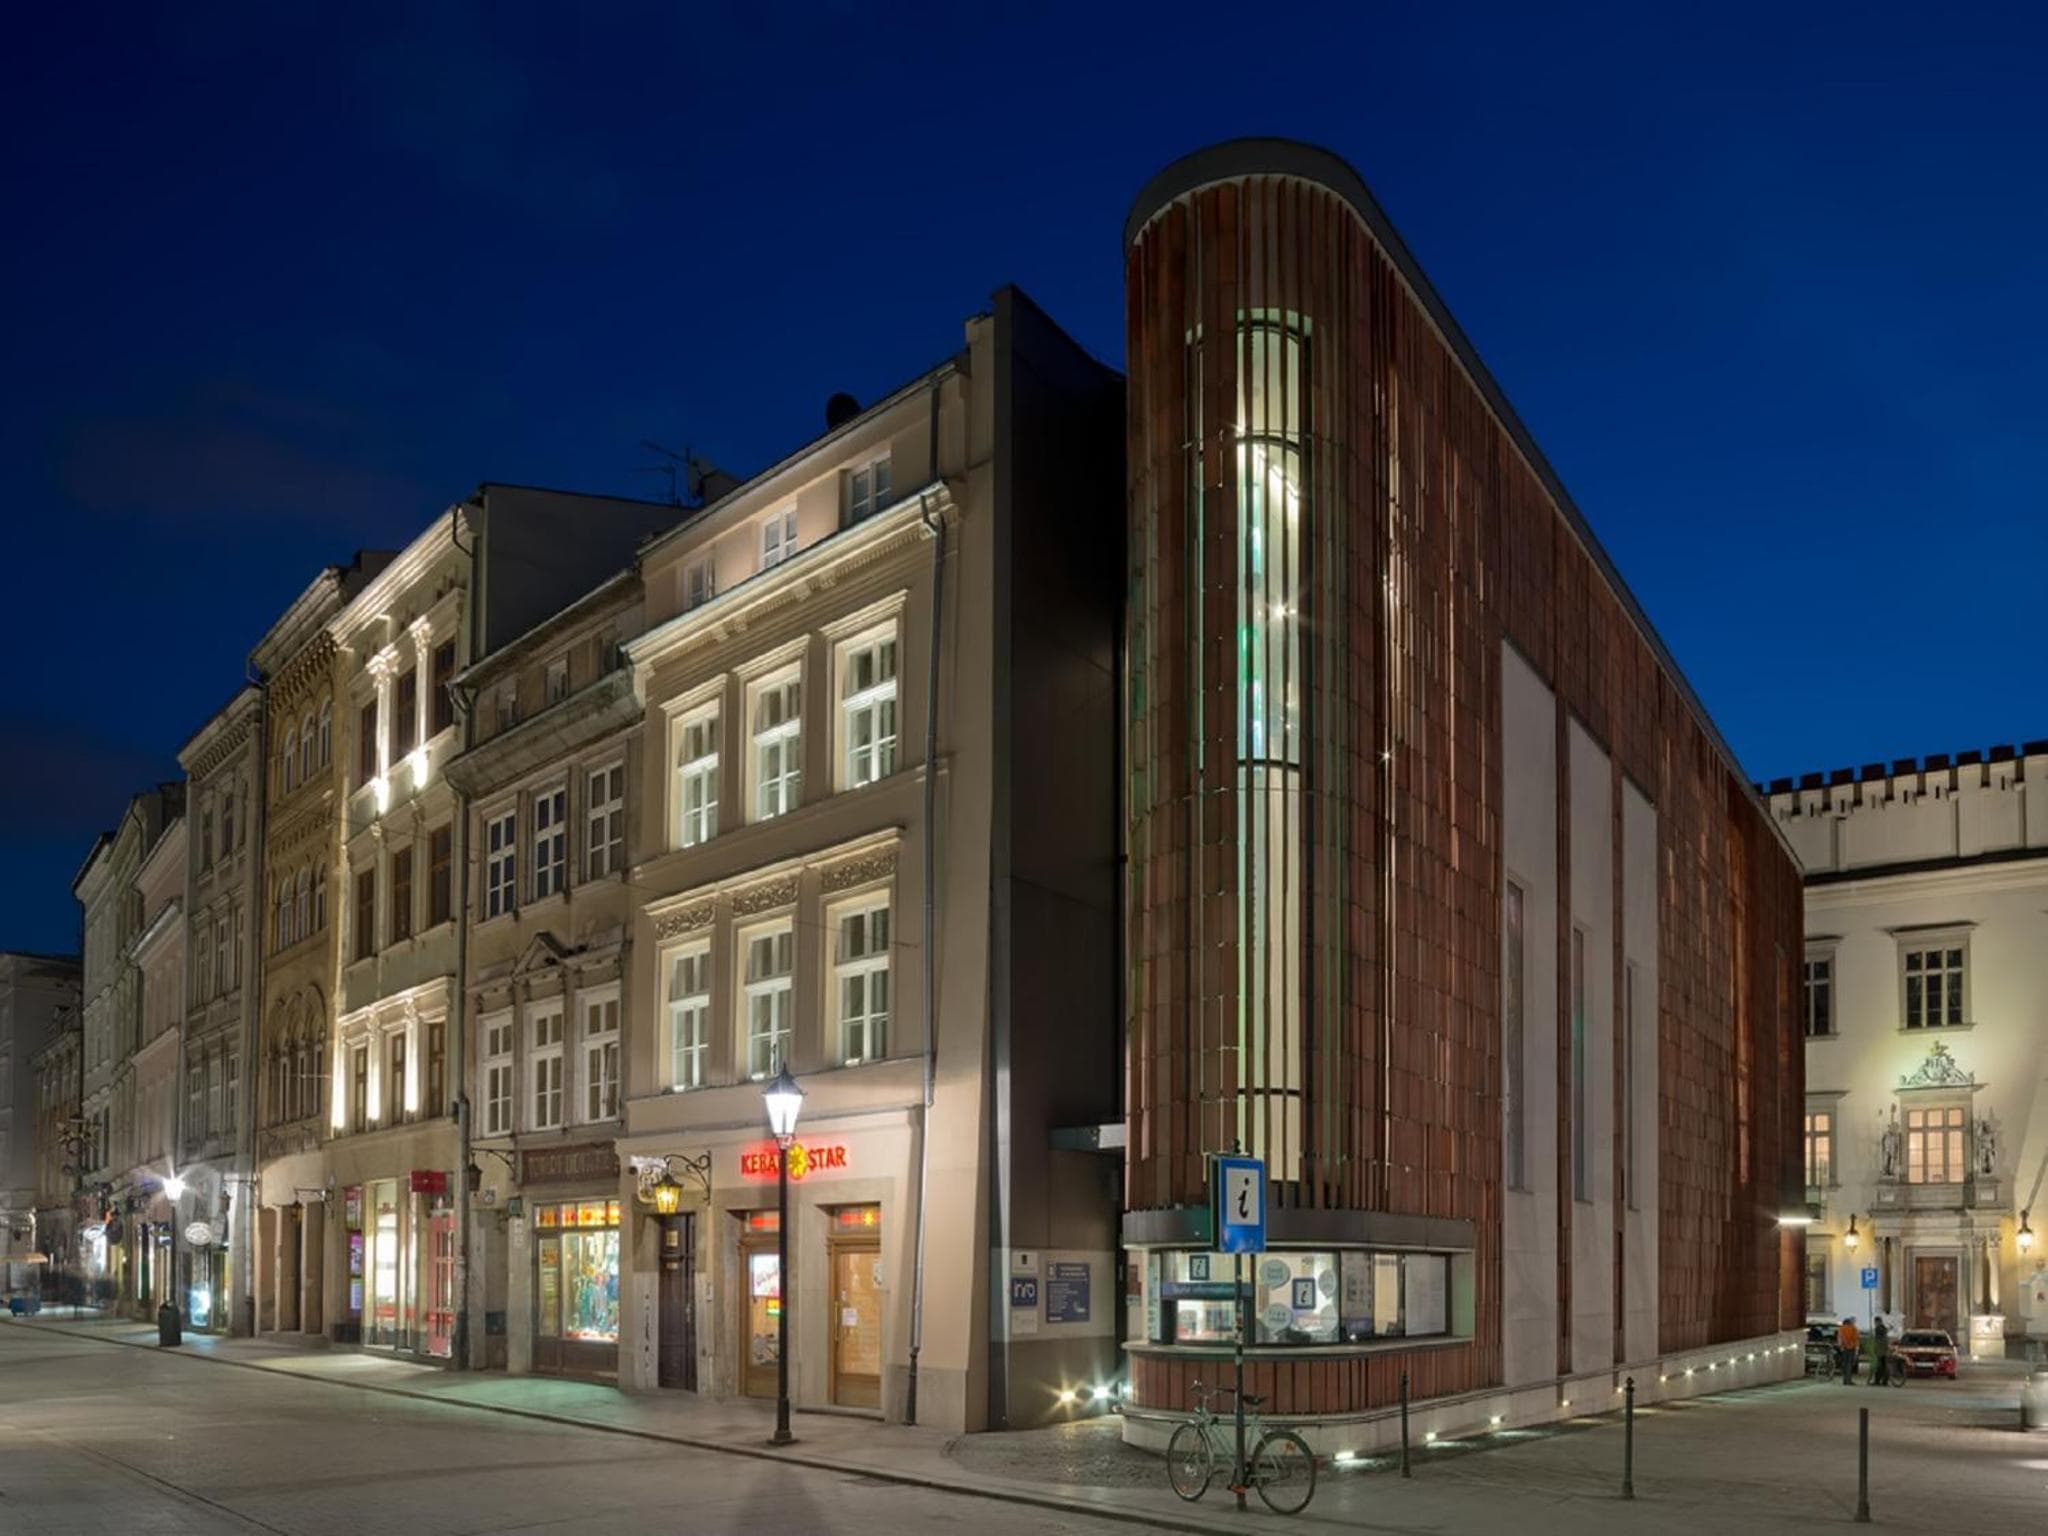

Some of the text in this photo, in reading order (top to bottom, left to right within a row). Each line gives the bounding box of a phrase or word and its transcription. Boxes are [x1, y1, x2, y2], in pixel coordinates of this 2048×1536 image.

[741, 1146, 847, 1175] KEBA STAR
[1238, 1176, 1250, 1219] i
[1865, 1269, 1876, 1284] P
